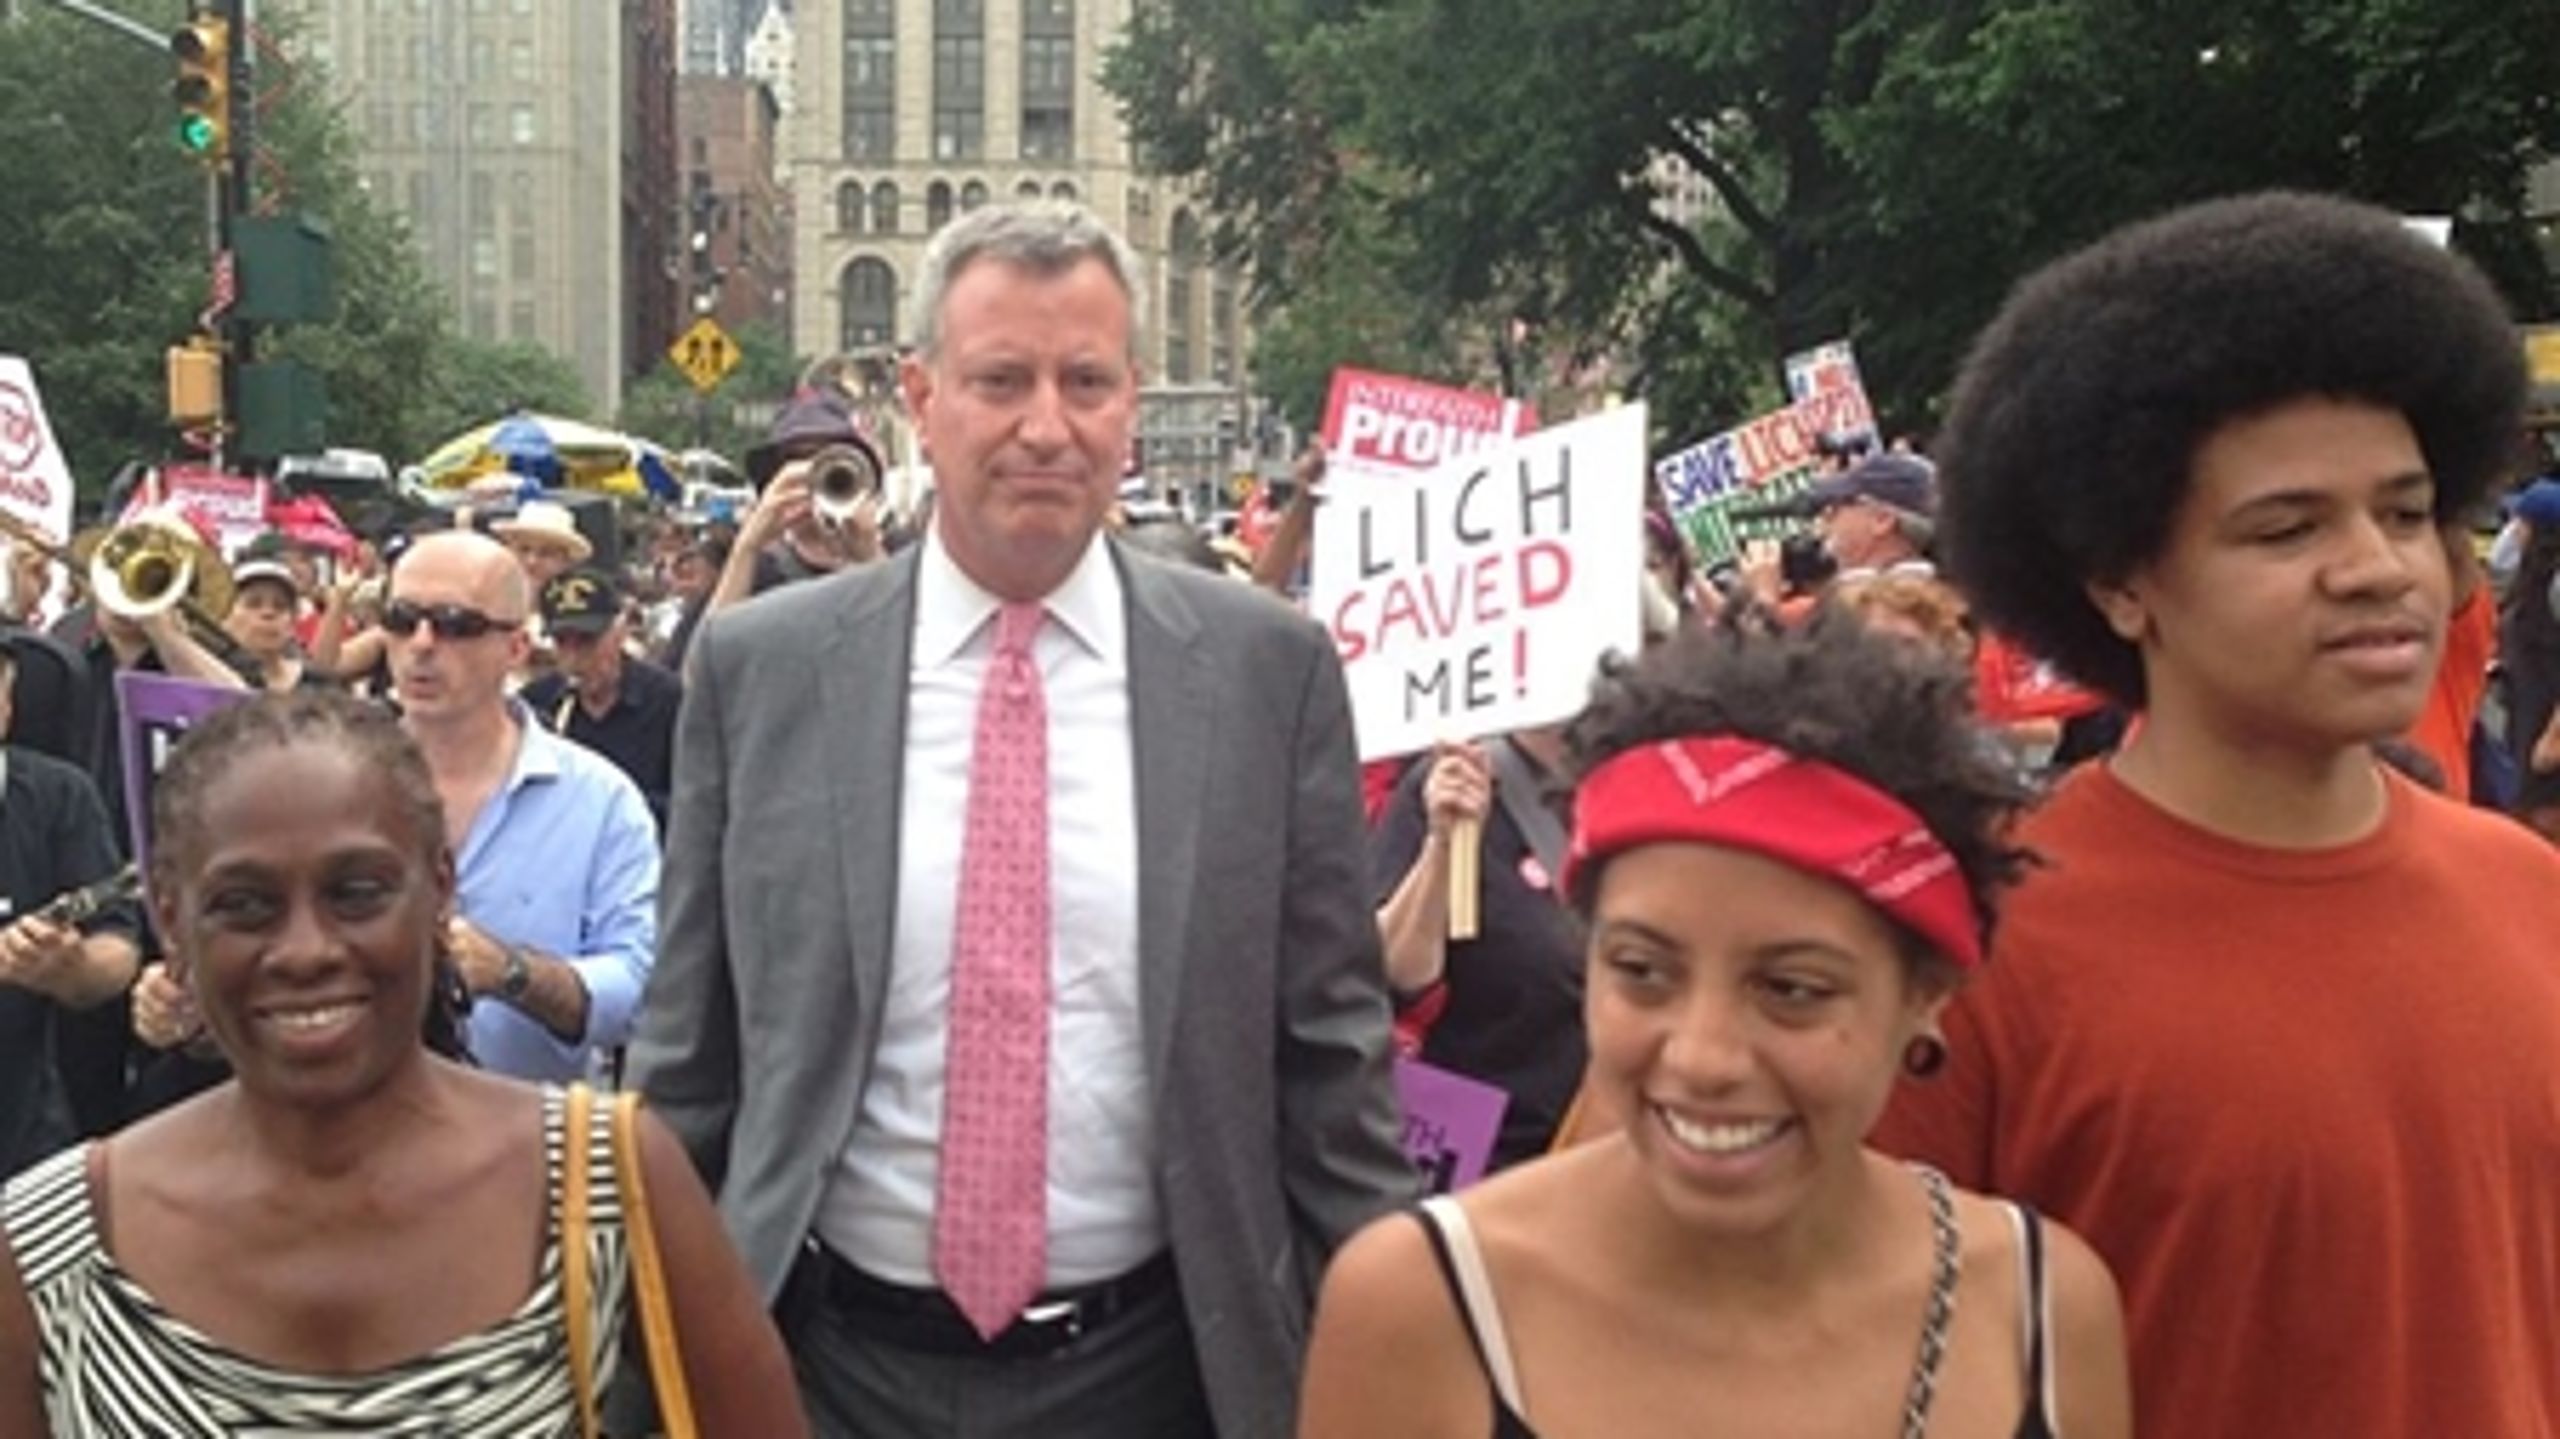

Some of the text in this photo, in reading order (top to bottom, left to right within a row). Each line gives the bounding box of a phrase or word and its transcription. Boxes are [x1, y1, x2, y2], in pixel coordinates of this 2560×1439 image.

[1359, 446, 1572, 580] LICH
[1663, 430, 1741, 510] SAVE
[1334, 540, 1573, 664] SAVED
[1404, 627, 1527, 722] ME!
